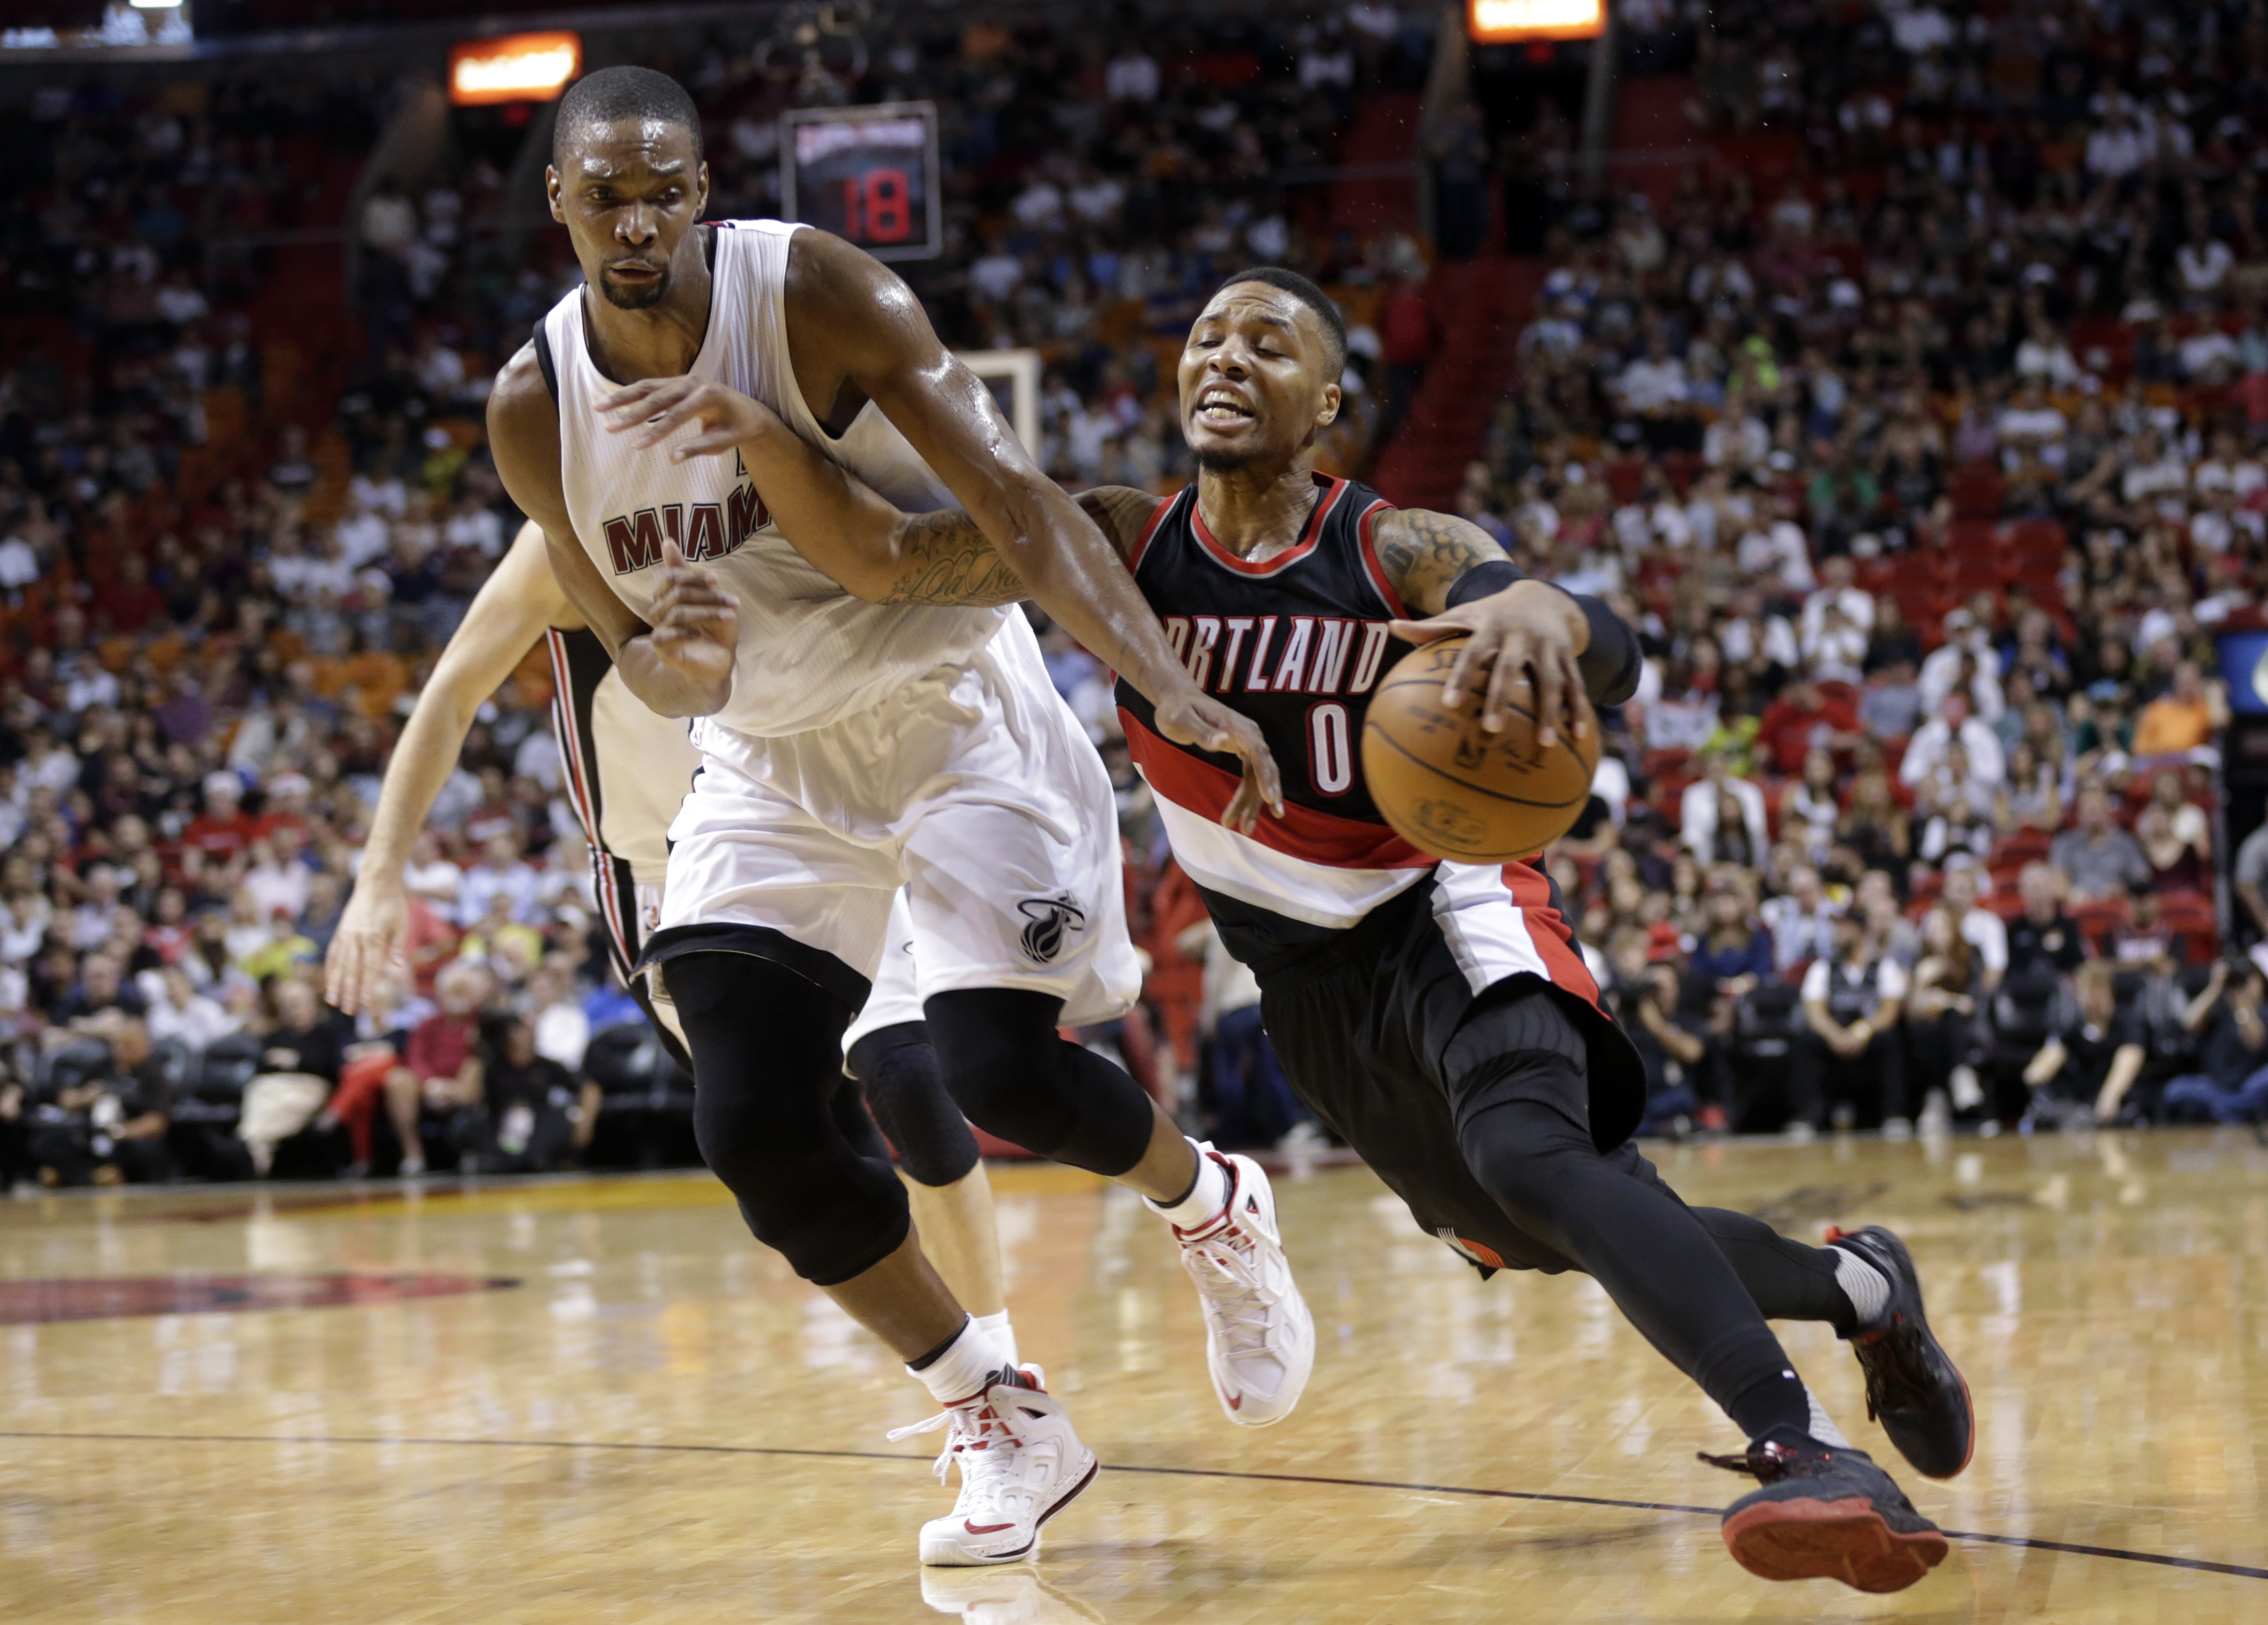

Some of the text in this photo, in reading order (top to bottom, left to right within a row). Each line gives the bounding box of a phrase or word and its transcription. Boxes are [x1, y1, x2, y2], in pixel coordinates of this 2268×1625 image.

[843, 168, 911, 244] 18
[602, 482, 771, 575] MIAM
[1162, 615, 1389, 695] ORTLAND
[1305, 699, 1354, 797] 0
